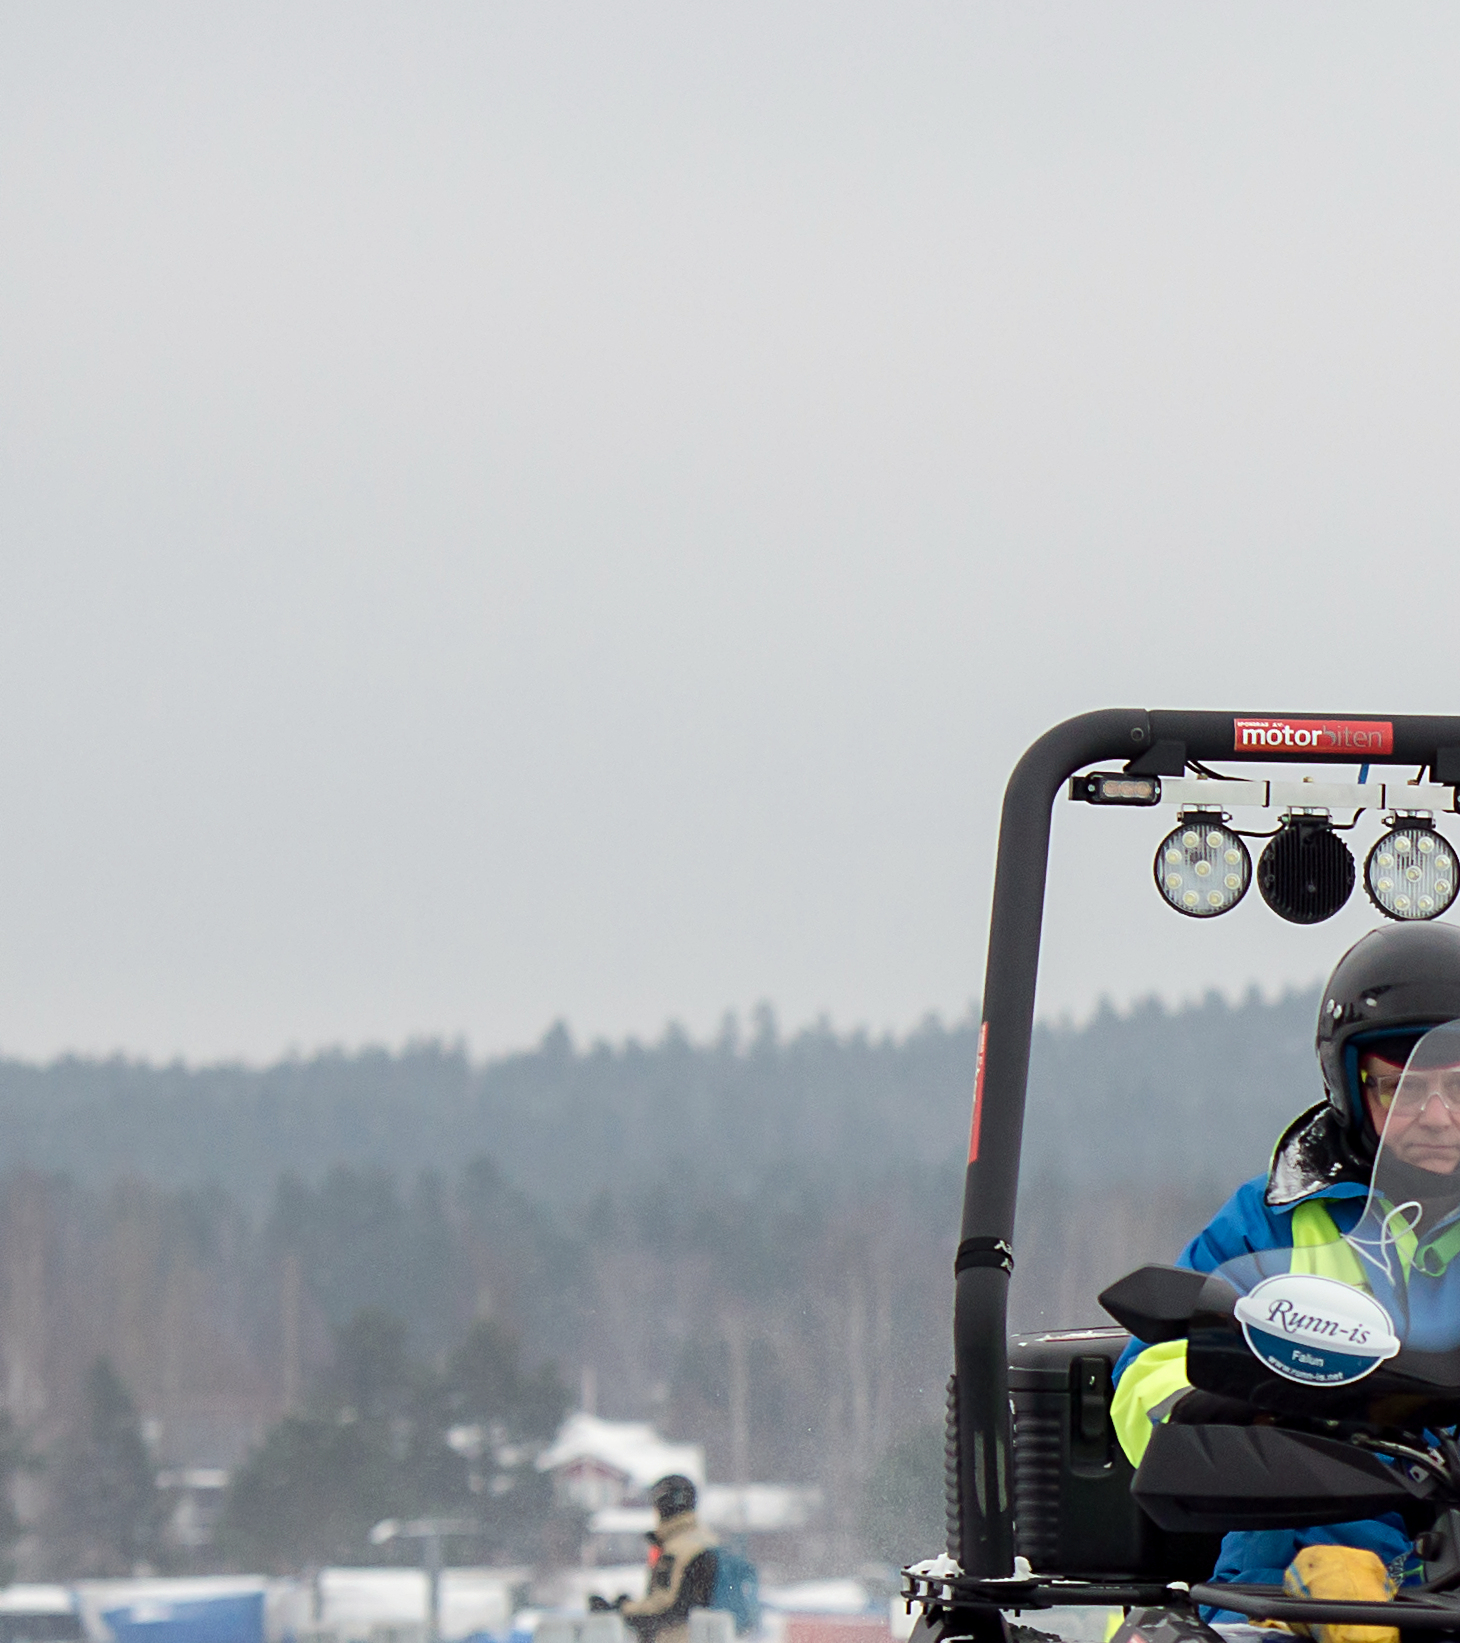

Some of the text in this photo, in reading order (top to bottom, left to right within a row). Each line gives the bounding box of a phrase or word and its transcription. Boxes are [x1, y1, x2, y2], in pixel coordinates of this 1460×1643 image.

[1266, 1299, 1371, 1345] Runn-is
[1267, 1355, 1344, 1382] www.runn-is.net
[1291, 1350, 1325, 1368] Falun
